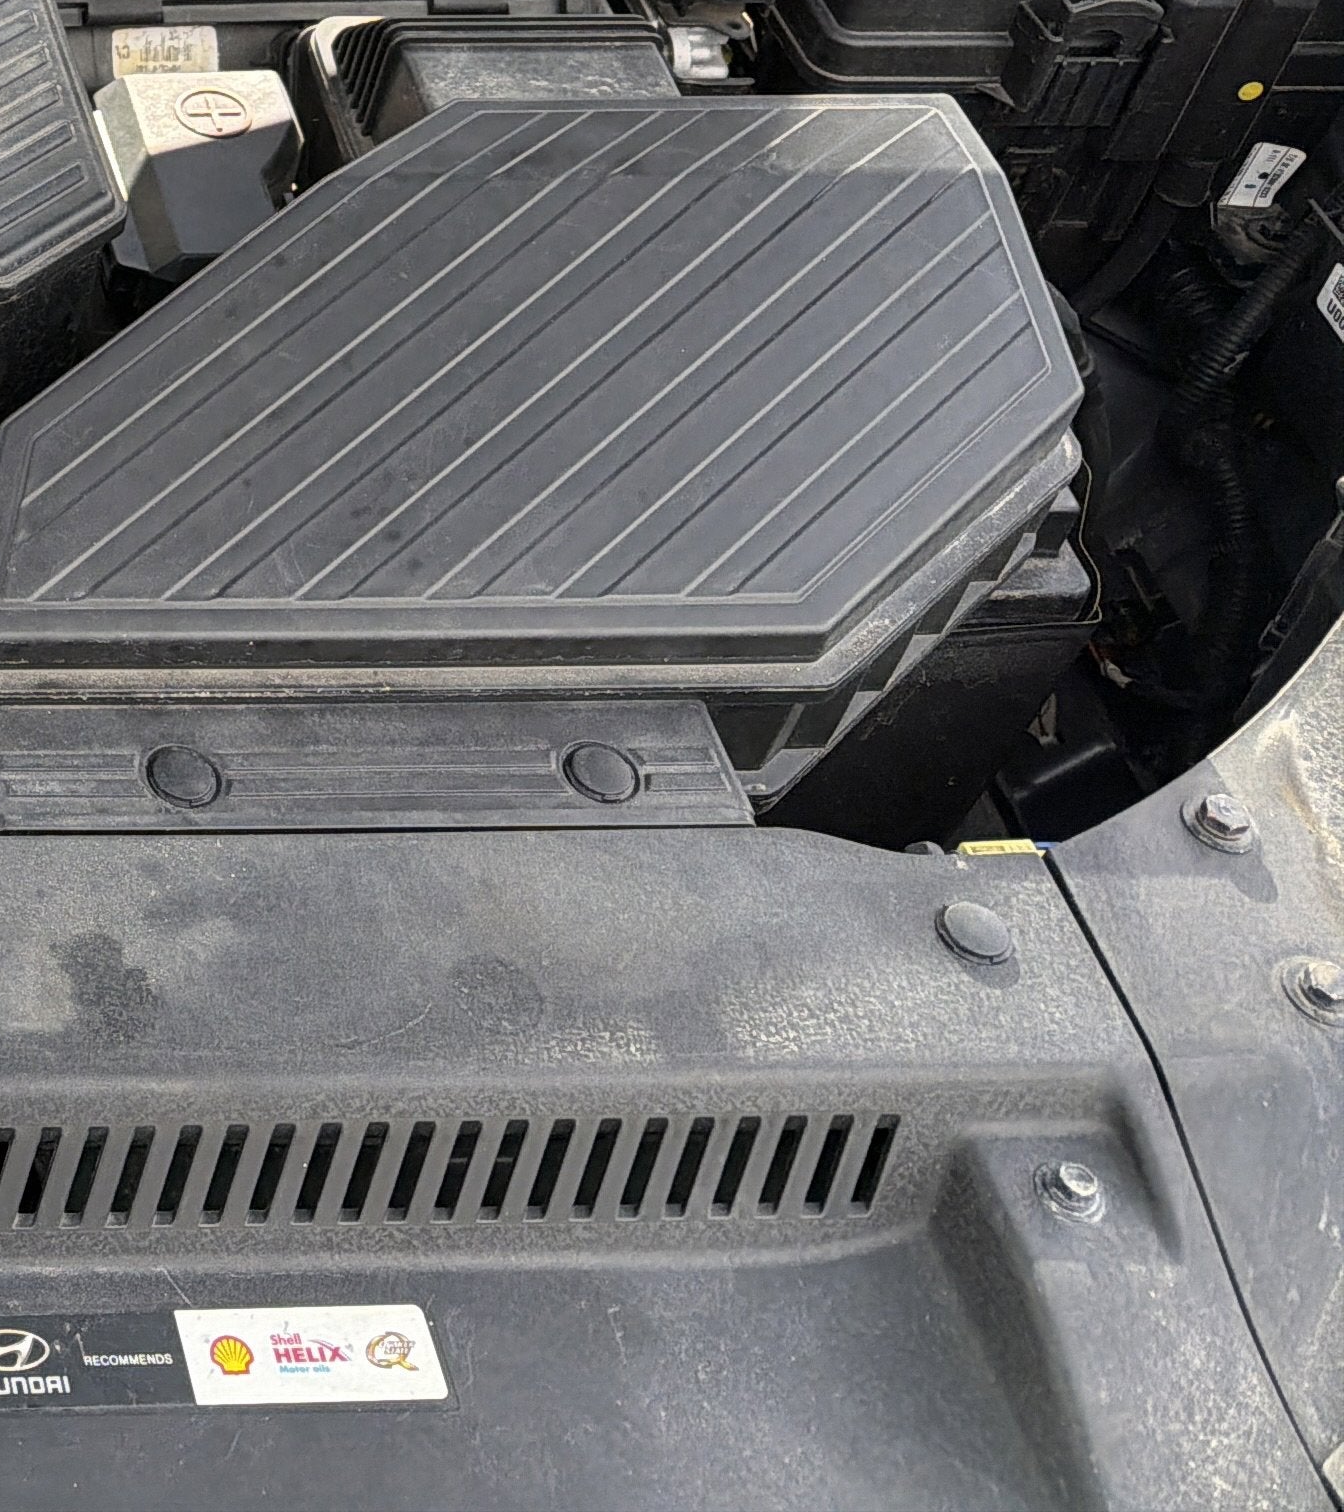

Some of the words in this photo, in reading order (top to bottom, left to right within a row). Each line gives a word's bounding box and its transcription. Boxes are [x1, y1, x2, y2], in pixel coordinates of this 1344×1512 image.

[270, 1333, 302, 1345] Shell
[84, 1354, 173, 1366] RECOMMENDS
[273, 1345, 348, 1364] HELIX
[279, 1364, 310, 1373] Motor
[313, 1364, 331, 1373] oils
